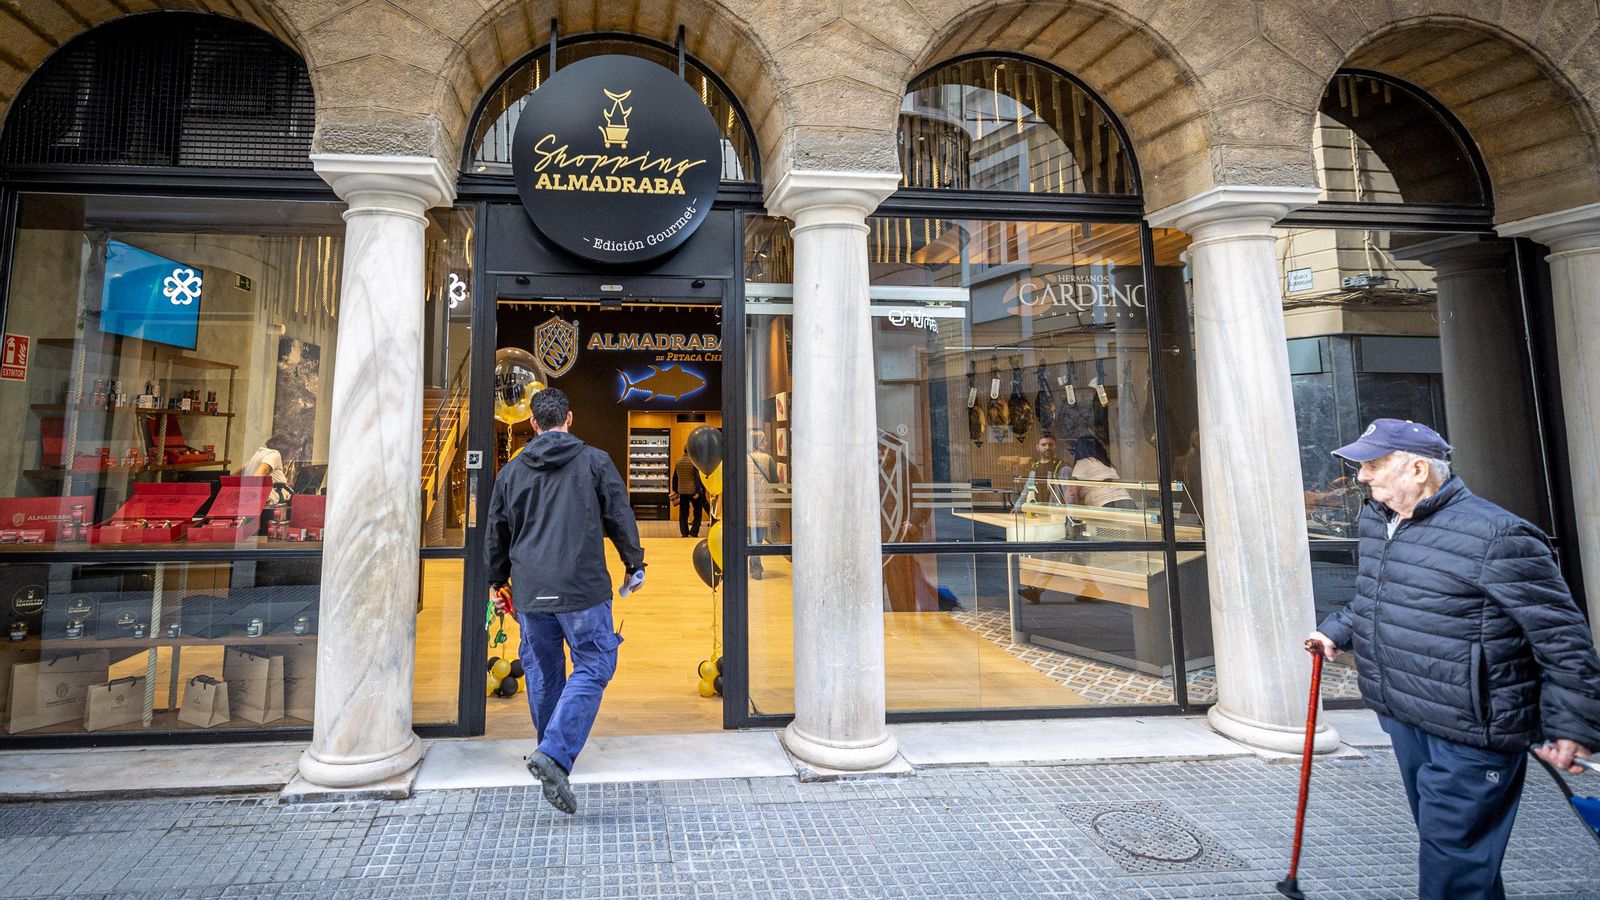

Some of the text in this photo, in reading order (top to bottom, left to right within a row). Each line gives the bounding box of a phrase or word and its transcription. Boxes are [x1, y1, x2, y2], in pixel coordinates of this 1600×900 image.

[533, 133, 706, 177] Shopping
[535, 172, 686, 194] ALMADRABA
[593, 237, 645, 252] Edición
[646, 205, 697, 246] Gourmet
[1058, 275, 1109, 283] HERMANOS
[587, 332, 722, 351] ALMADRAB
[3, 369, 24, 378] EXTINTOR
